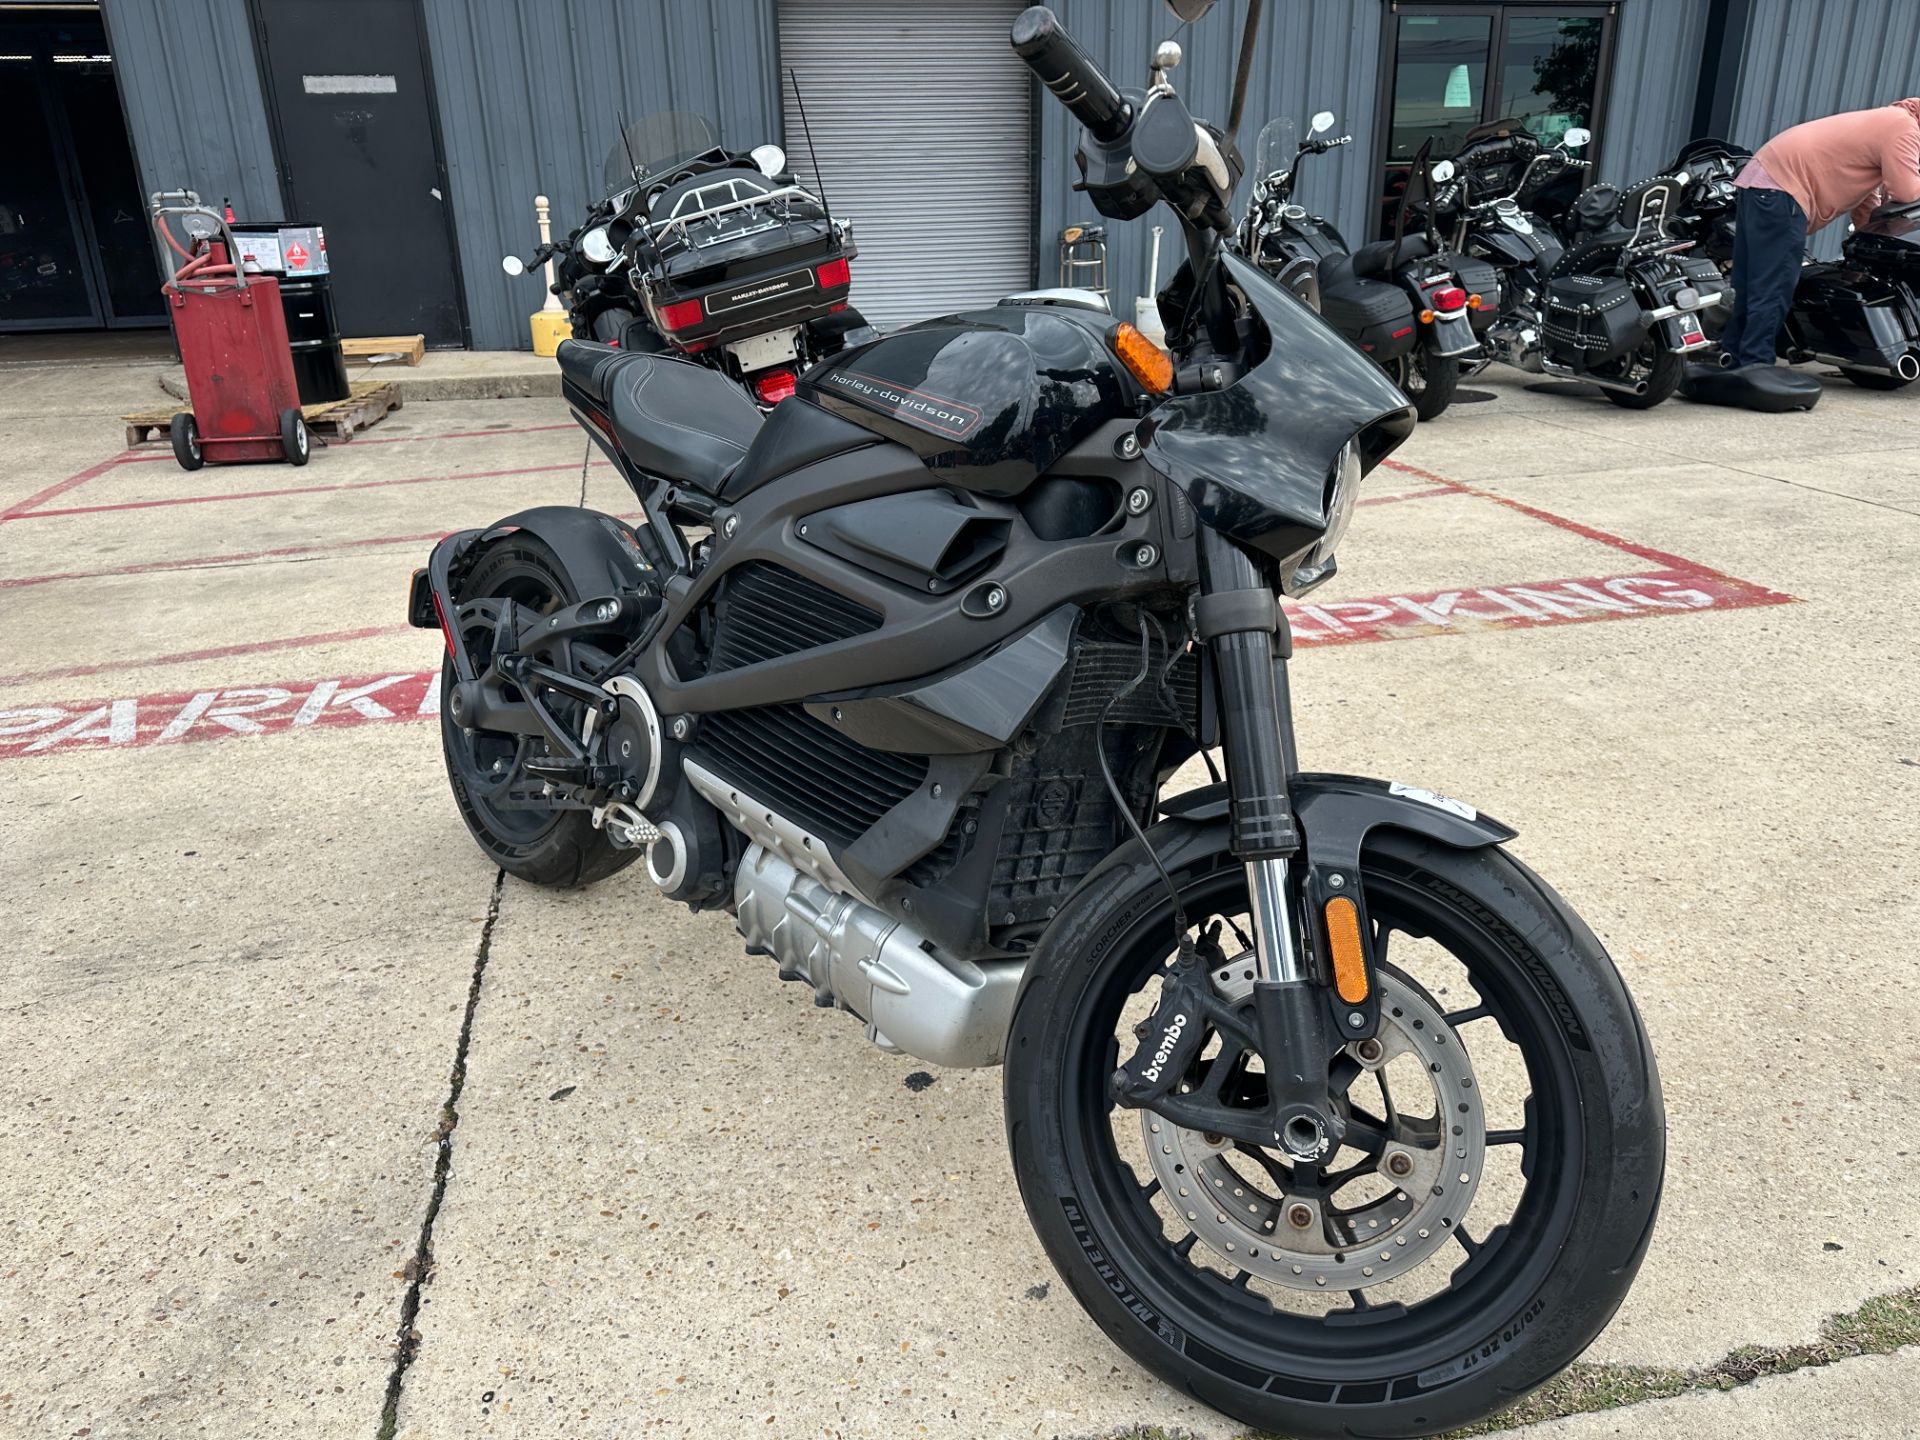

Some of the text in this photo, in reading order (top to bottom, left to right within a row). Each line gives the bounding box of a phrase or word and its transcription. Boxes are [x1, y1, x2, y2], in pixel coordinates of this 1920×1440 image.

[731, 282, 789, 301] HARLEY-DAVIDSON
[830, 373, 965, 426] harley-davidson
[1086, 910, 1132, 966] SCORCHER
[1427, 879, 1582, 1035] HARLEY-DAVIDSON
[1141, 1014, 1187, 1083] brembo
[1063, 1205, 1154, 1321] MICHELIN
[1463, 1298, 1546, 1370] 120/70 ZR 17
